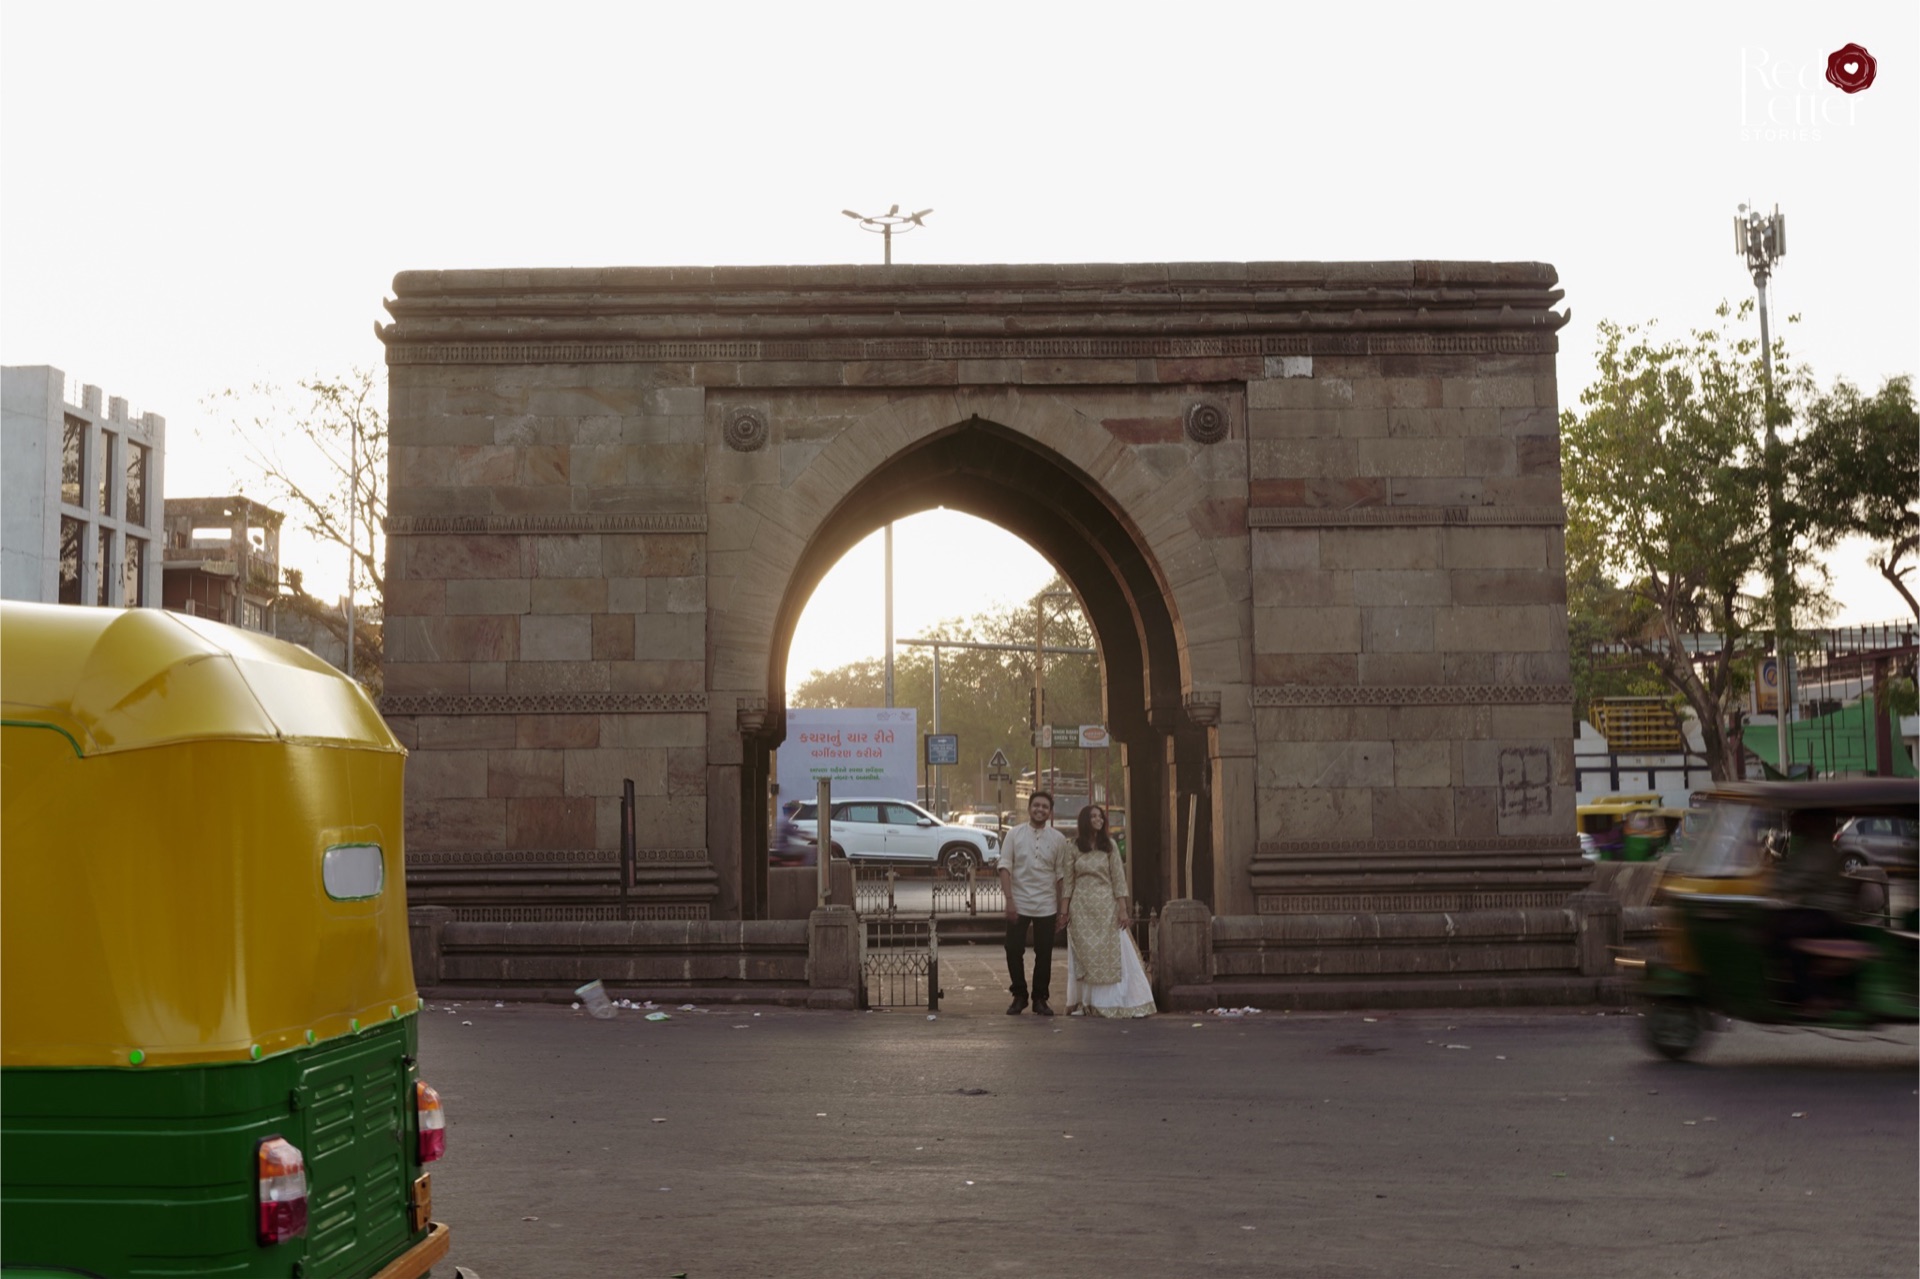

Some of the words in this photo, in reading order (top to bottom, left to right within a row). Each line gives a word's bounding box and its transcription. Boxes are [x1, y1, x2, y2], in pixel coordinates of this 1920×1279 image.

[799, 730, 842, 747] કચરાનું
[847, 732, 868, 743] ચાર
[874, 729, 895, 743] રીતે
[811, 747, 851, 758] વર્ગીકરણ
[856, 747, 882, 758] કરીએ
